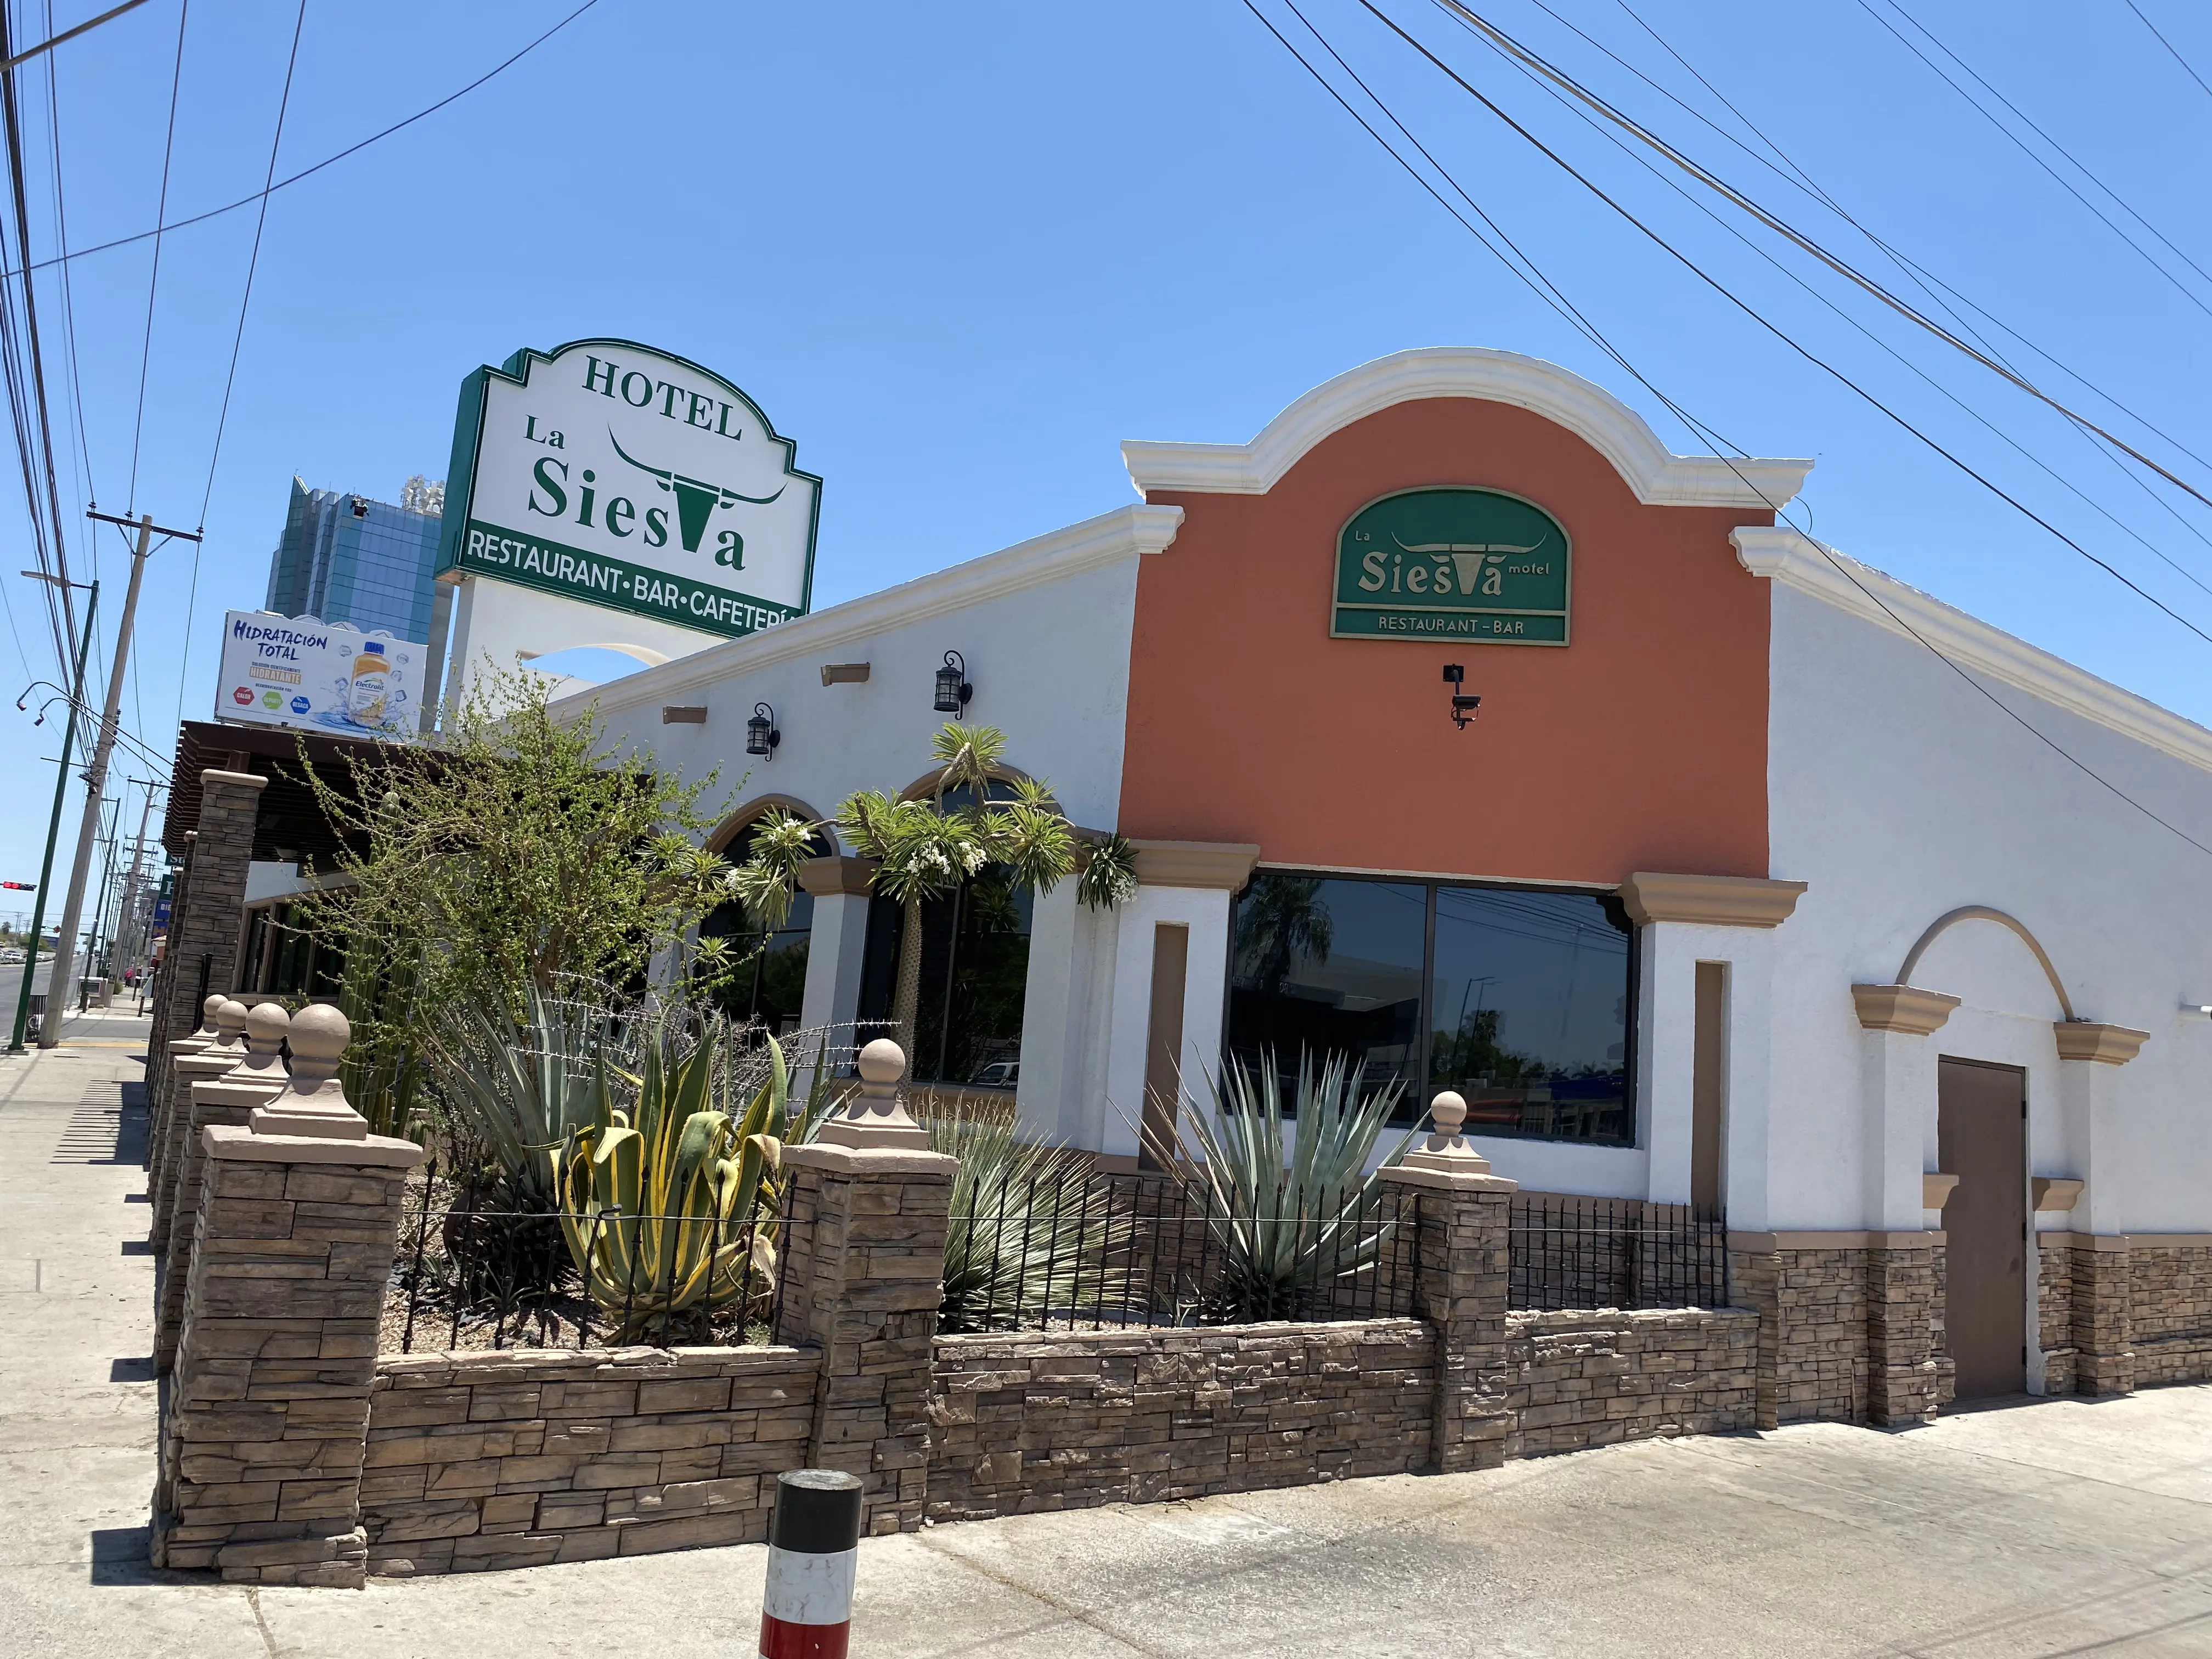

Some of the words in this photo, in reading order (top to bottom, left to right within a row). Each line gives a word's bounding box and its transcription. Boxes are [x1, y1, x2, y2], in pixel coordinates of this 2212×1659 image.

[582, 354, 742, 441] HOTEL
[523, 414, 565, 449] La
[1355, 530, 1370, 541] La
[1508, 562, 1550, 575] motel
[467, 529, 623, 594] RESTAURANT
[634, 577, 680, 610] BAR
[690, 590, 795, 631] CAFETERÍ
[1378, 616, 1478, 633] RESTAURANT
[1493, 620, 1523, 634] BAR
[234, 619, 328, 650] HIDRATACIÓN
[257, 642, 300, 660] TOTAL
[250, 667, 301, 685] HIDRATANTE
[356, 680, 384, 691] Electrolit
